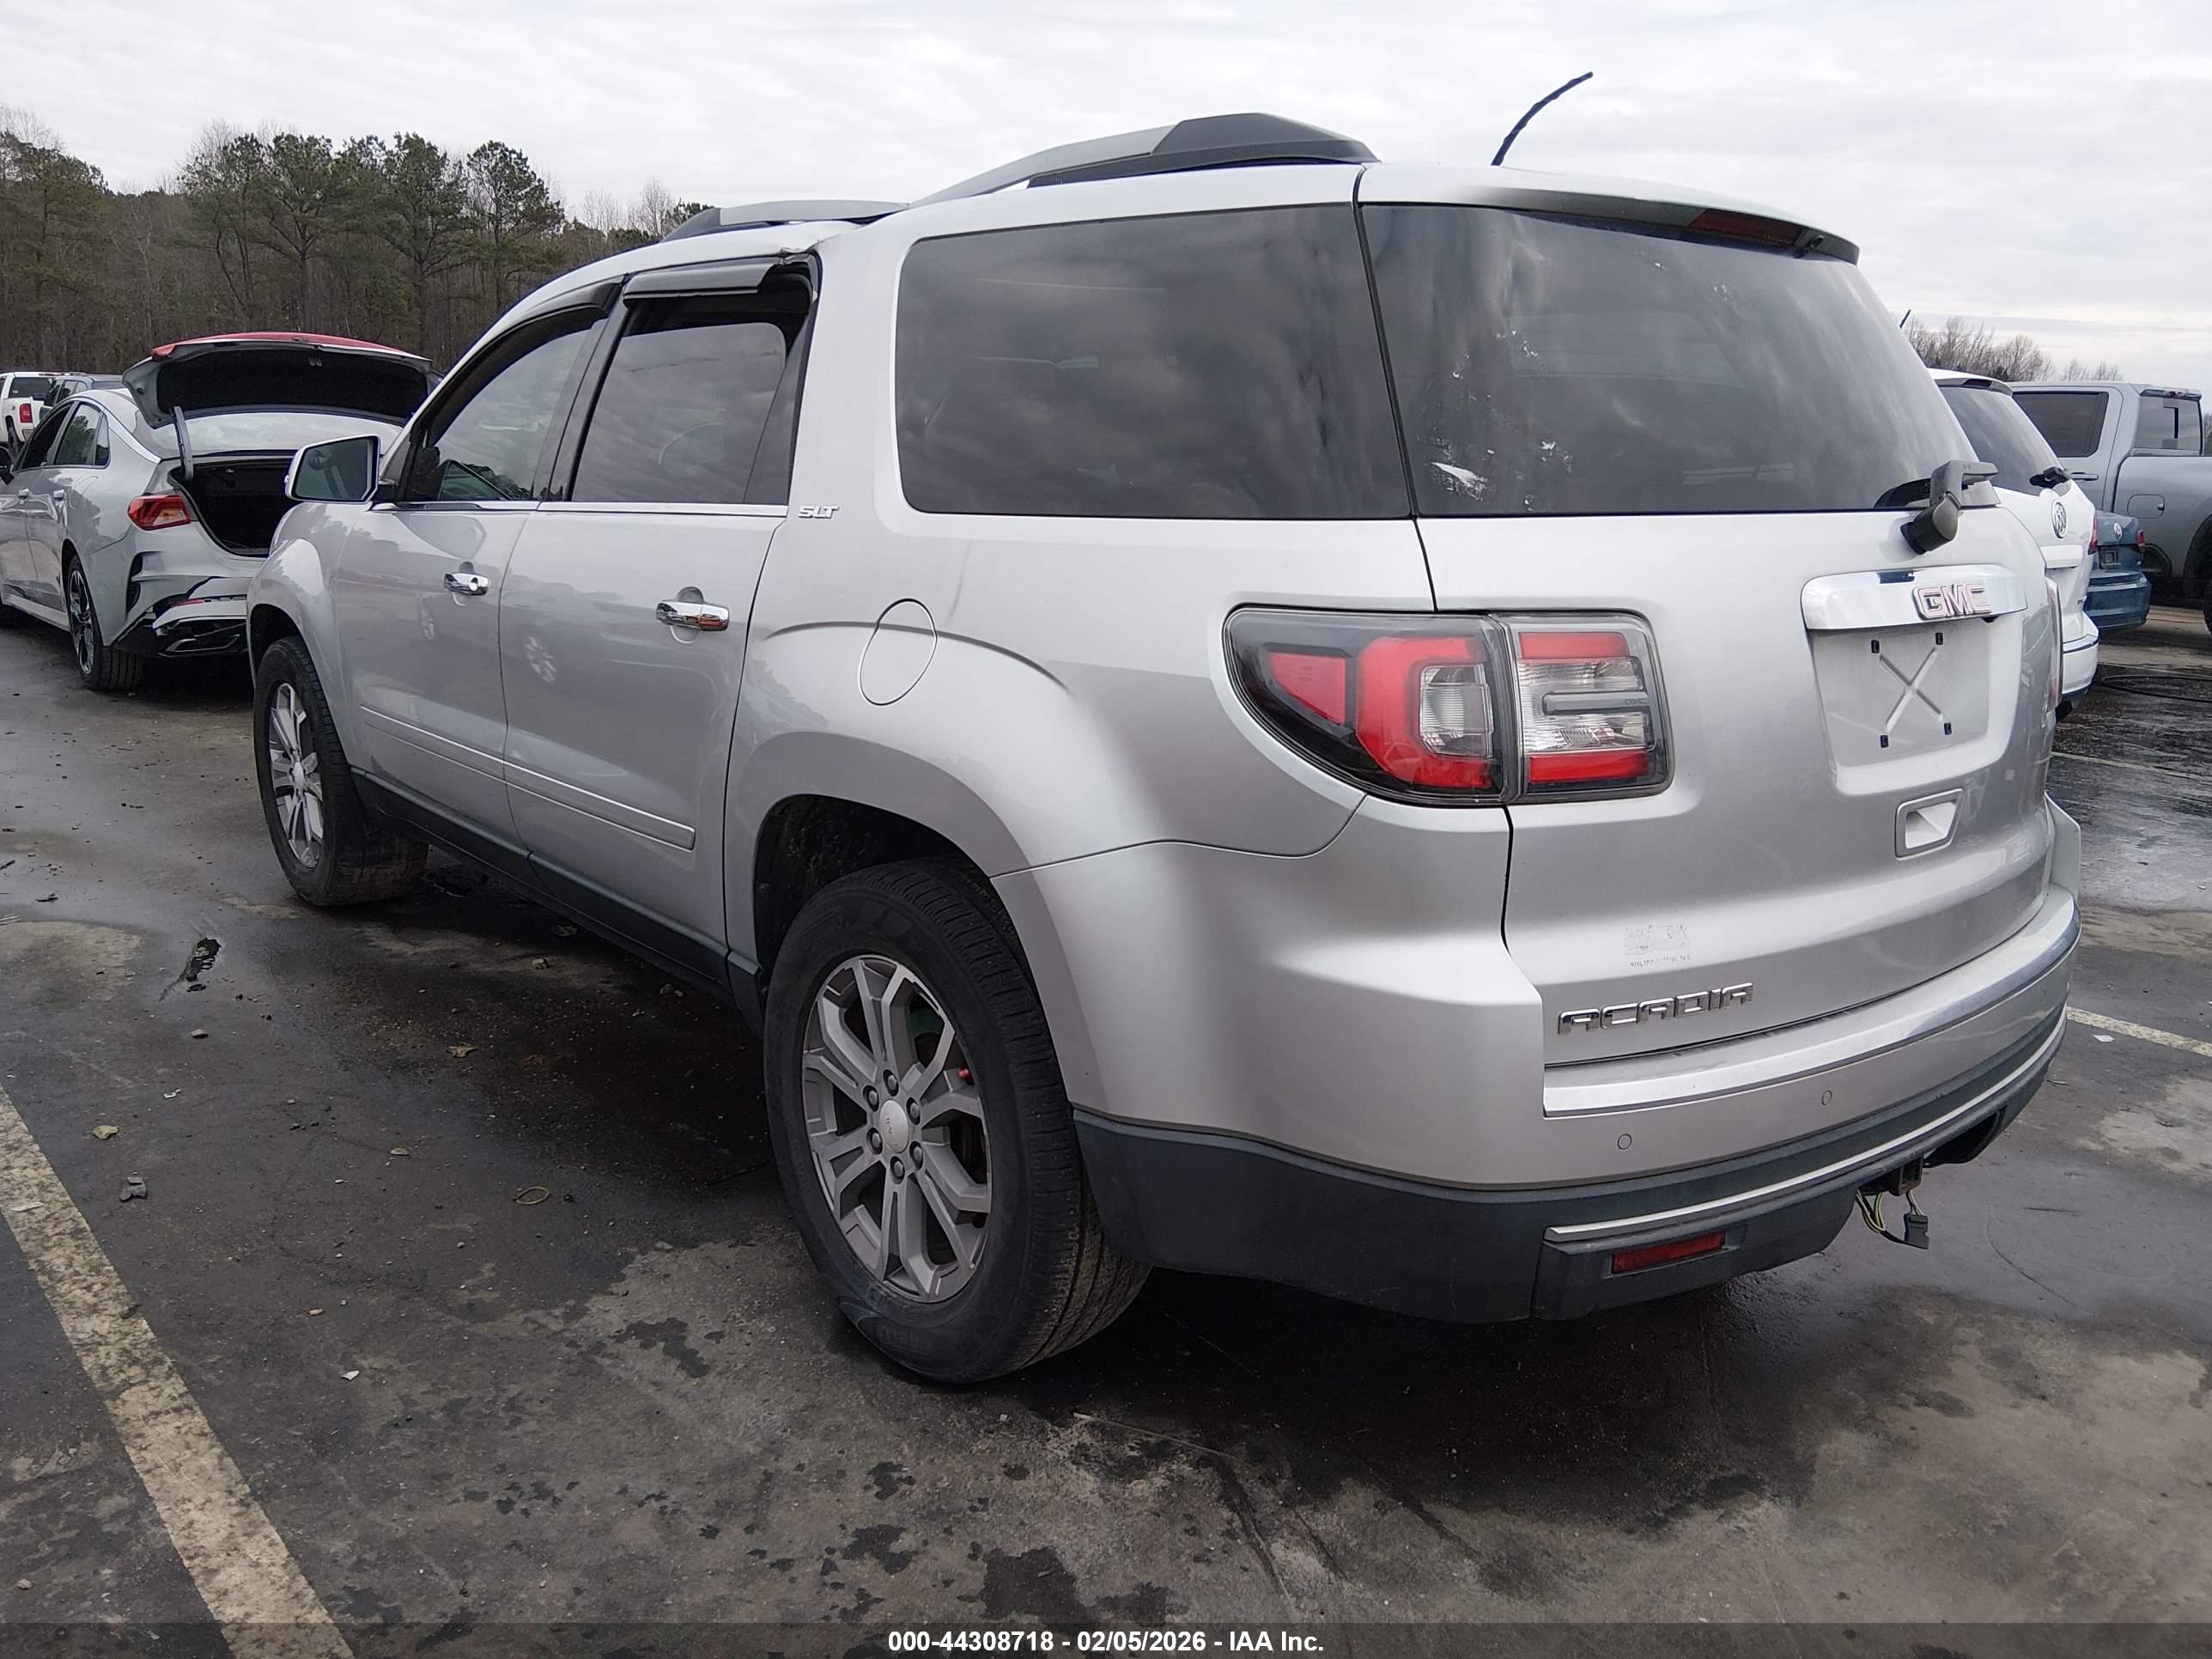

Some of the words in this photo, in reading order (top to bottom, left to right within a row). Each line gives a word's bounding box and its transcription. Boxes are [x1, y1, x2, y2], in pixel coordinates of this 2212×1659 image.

[798, 506, 839, 519] SLT
[1912, 584, 1992, 620] GMC
[1558, 982, 1753, 1034] ACADIA
